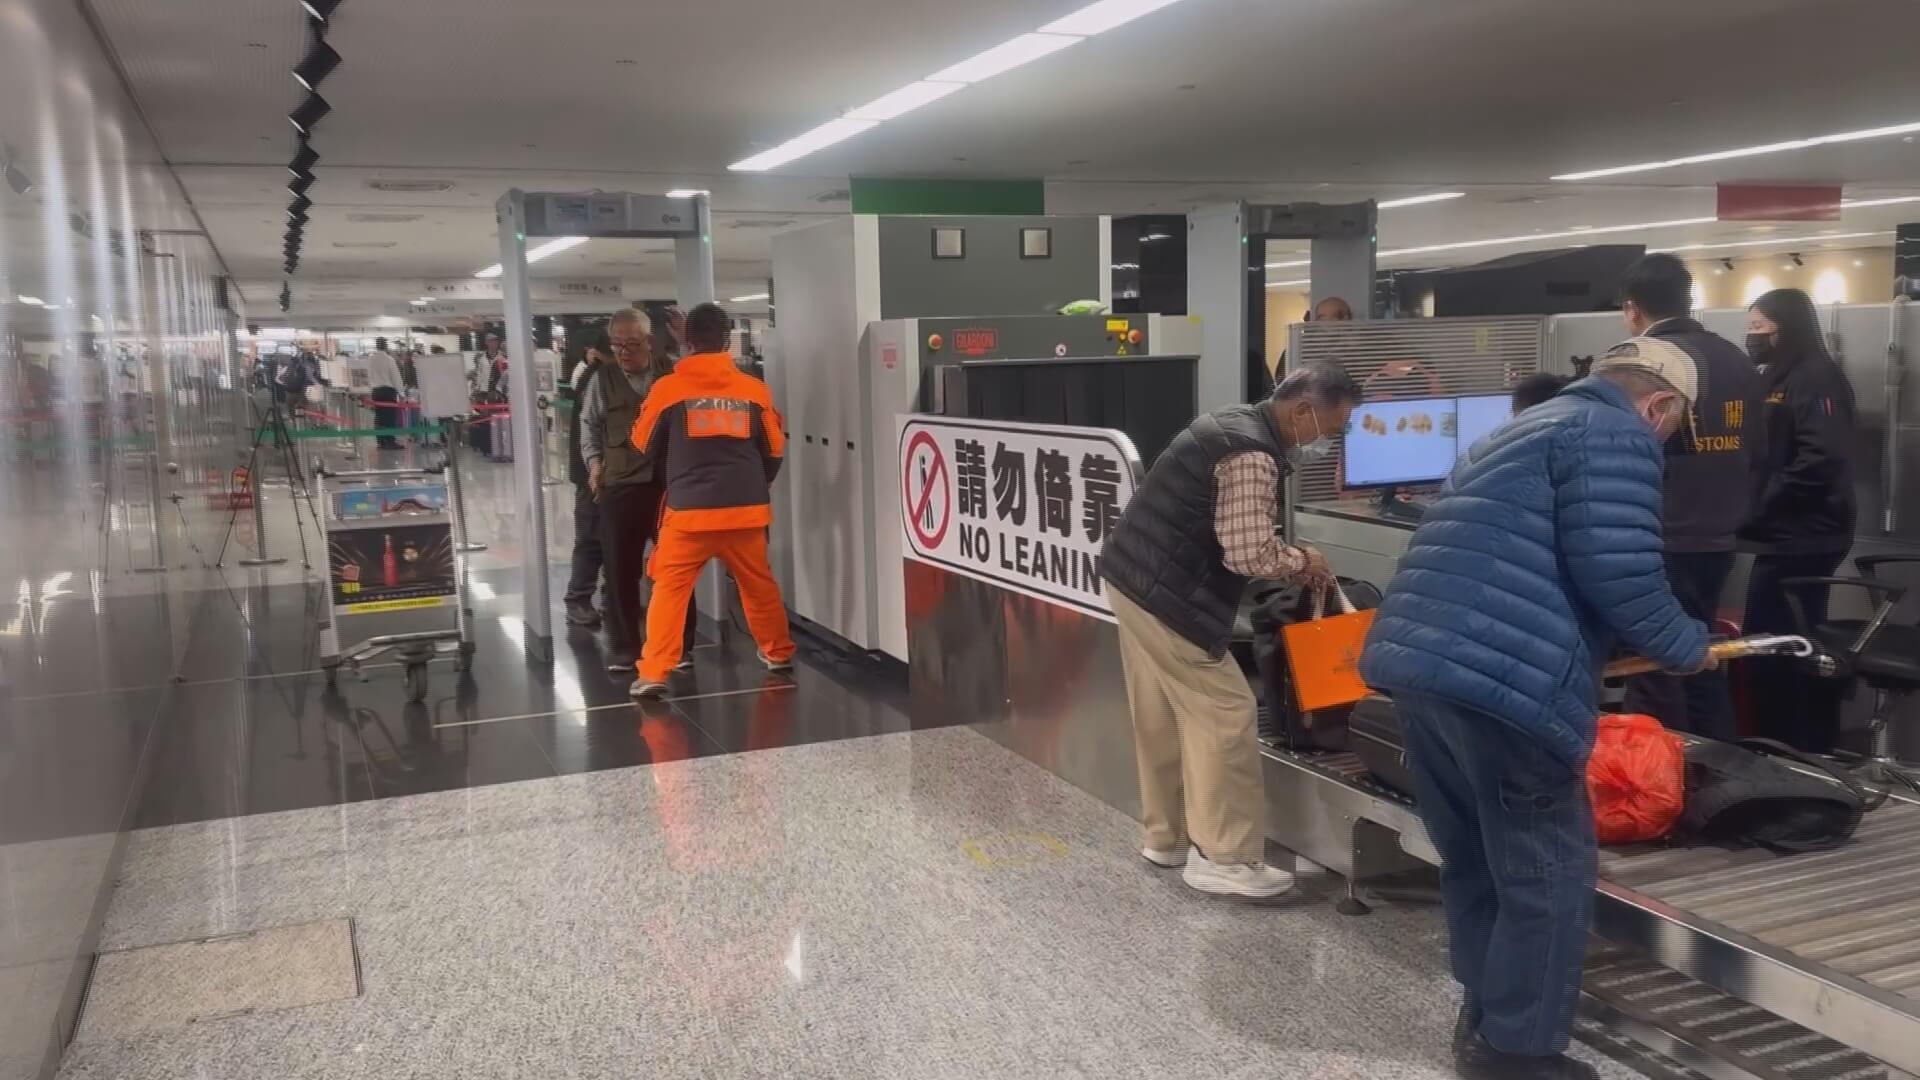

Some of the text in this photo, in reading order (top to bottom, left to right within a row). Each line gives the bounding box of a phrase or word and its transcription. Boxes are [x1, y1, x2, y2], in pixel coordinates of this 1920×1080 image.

[1694, 435, 1742, 451] STOMS
[955, 438, 1122, 544] 請勿倚靠
[958, 522, 1102, 596] NO LEANIN
